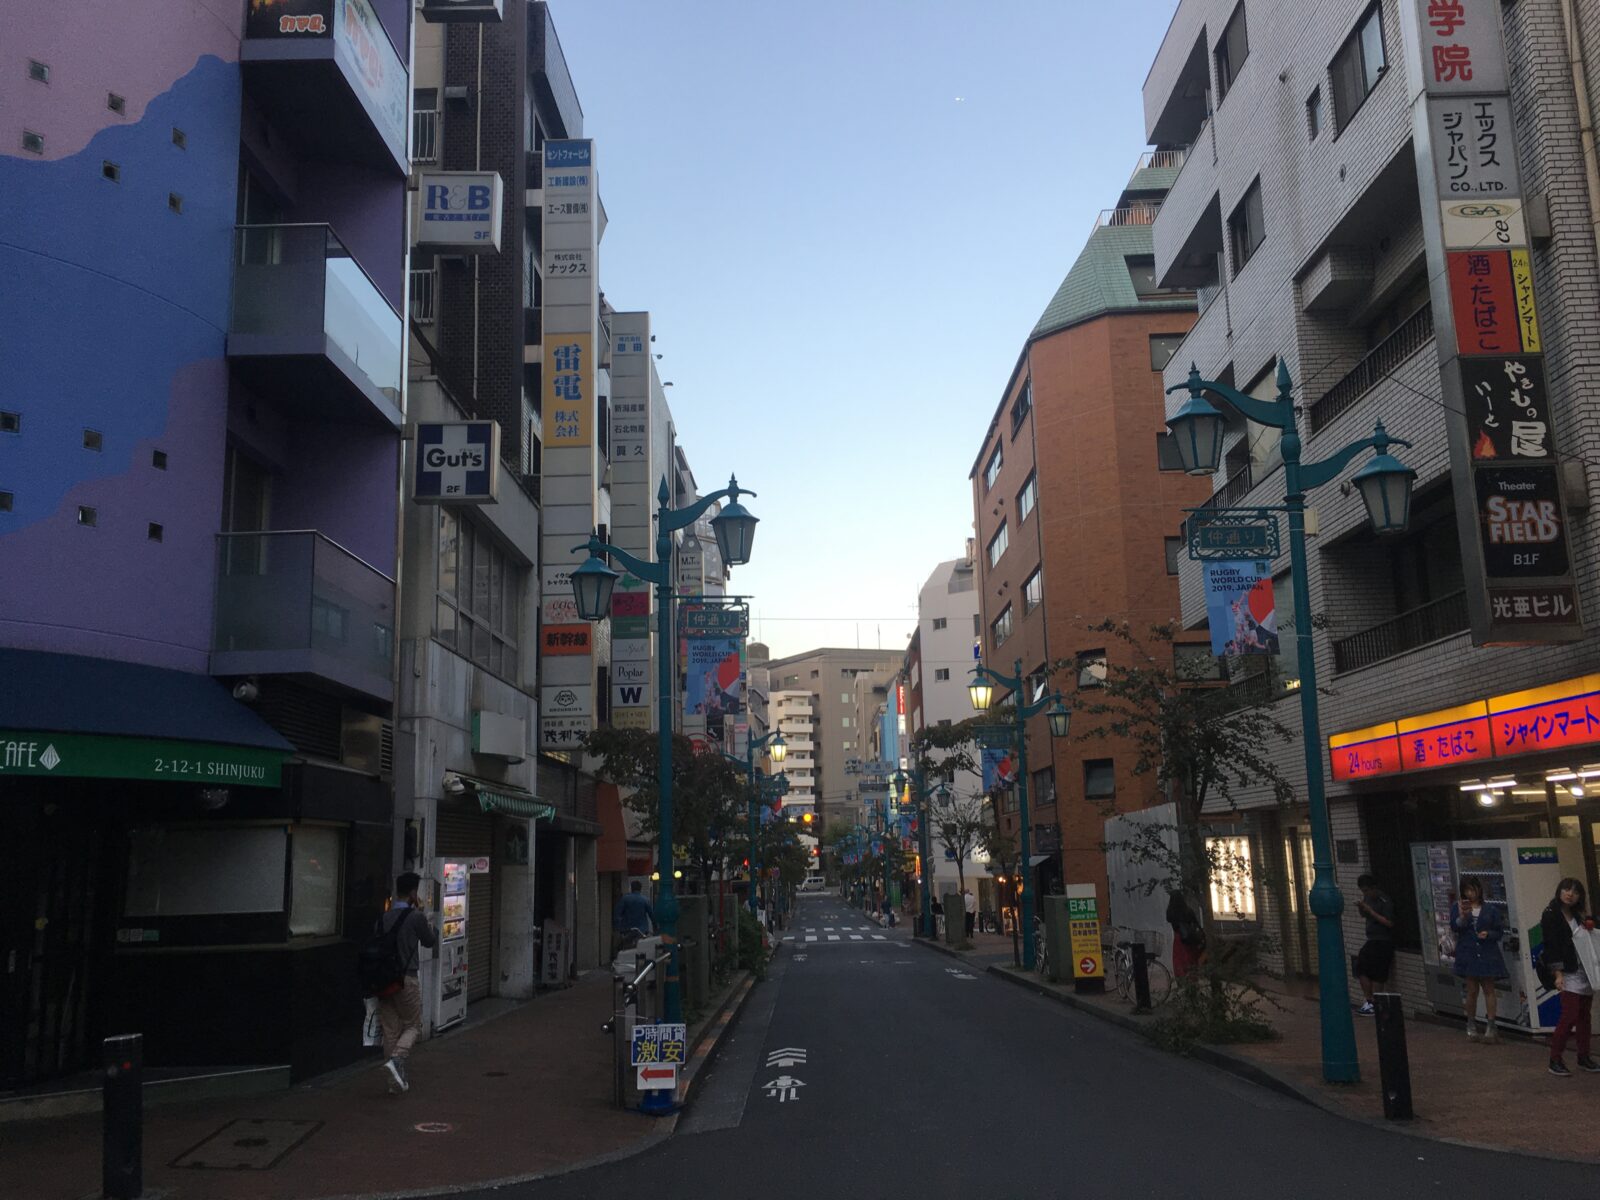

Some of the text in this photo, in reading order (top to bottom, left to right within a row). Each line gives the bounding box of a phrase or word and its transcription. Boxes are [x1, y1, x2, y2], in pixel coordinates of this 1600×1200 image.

[1428, 0, 1473, 82] 学院
[1474, 102, 1501, 167] エックス
[1443, 112, 1468, 179] ジャパン
[425, 185, 490, 210] R&B
[473, 231, 490, 240] 3F
[548, 263, 587, 274] ナックス
[1468, 254, 1500, 350] 酒・たばこ
[1517, 274, 1536, 348] シャインマート
[555, 410, 579, 423] 株式
[555, 425, 580, 438] 会社
[427, 448, 482, 467] Gut's
[446, 485, 461, 493] 2F
[1497, 481, 1537, 491] Theater
[1487, 496, 1557, 521] STAR
[1207, 530, 1256, 545] 仲通り
[1489, 520, 1559, 544] FIELD
[1513, 553, 1540, 566] B1F
[1210, 568, 1240, 577] RUGBY
[1211, 575, 1263, 584] WORLD CUP
[1236, 583, 1264, 592] JAPAN
[1492, 594, 1573, 618] 光亜ビル
[618, 666, 643, 679] Poplar
[620, 687, 642, 704] W
[1504, 704, 1600, 747] シャインマート
[1414, 730, 1478, 763] 酒・たばこ
[154, 758, 265, 780] 2-12-1 SHINJUKU
[1348, 752, 1383, 774] 24 hours
[637, 1041, 682, 1061] 激安
